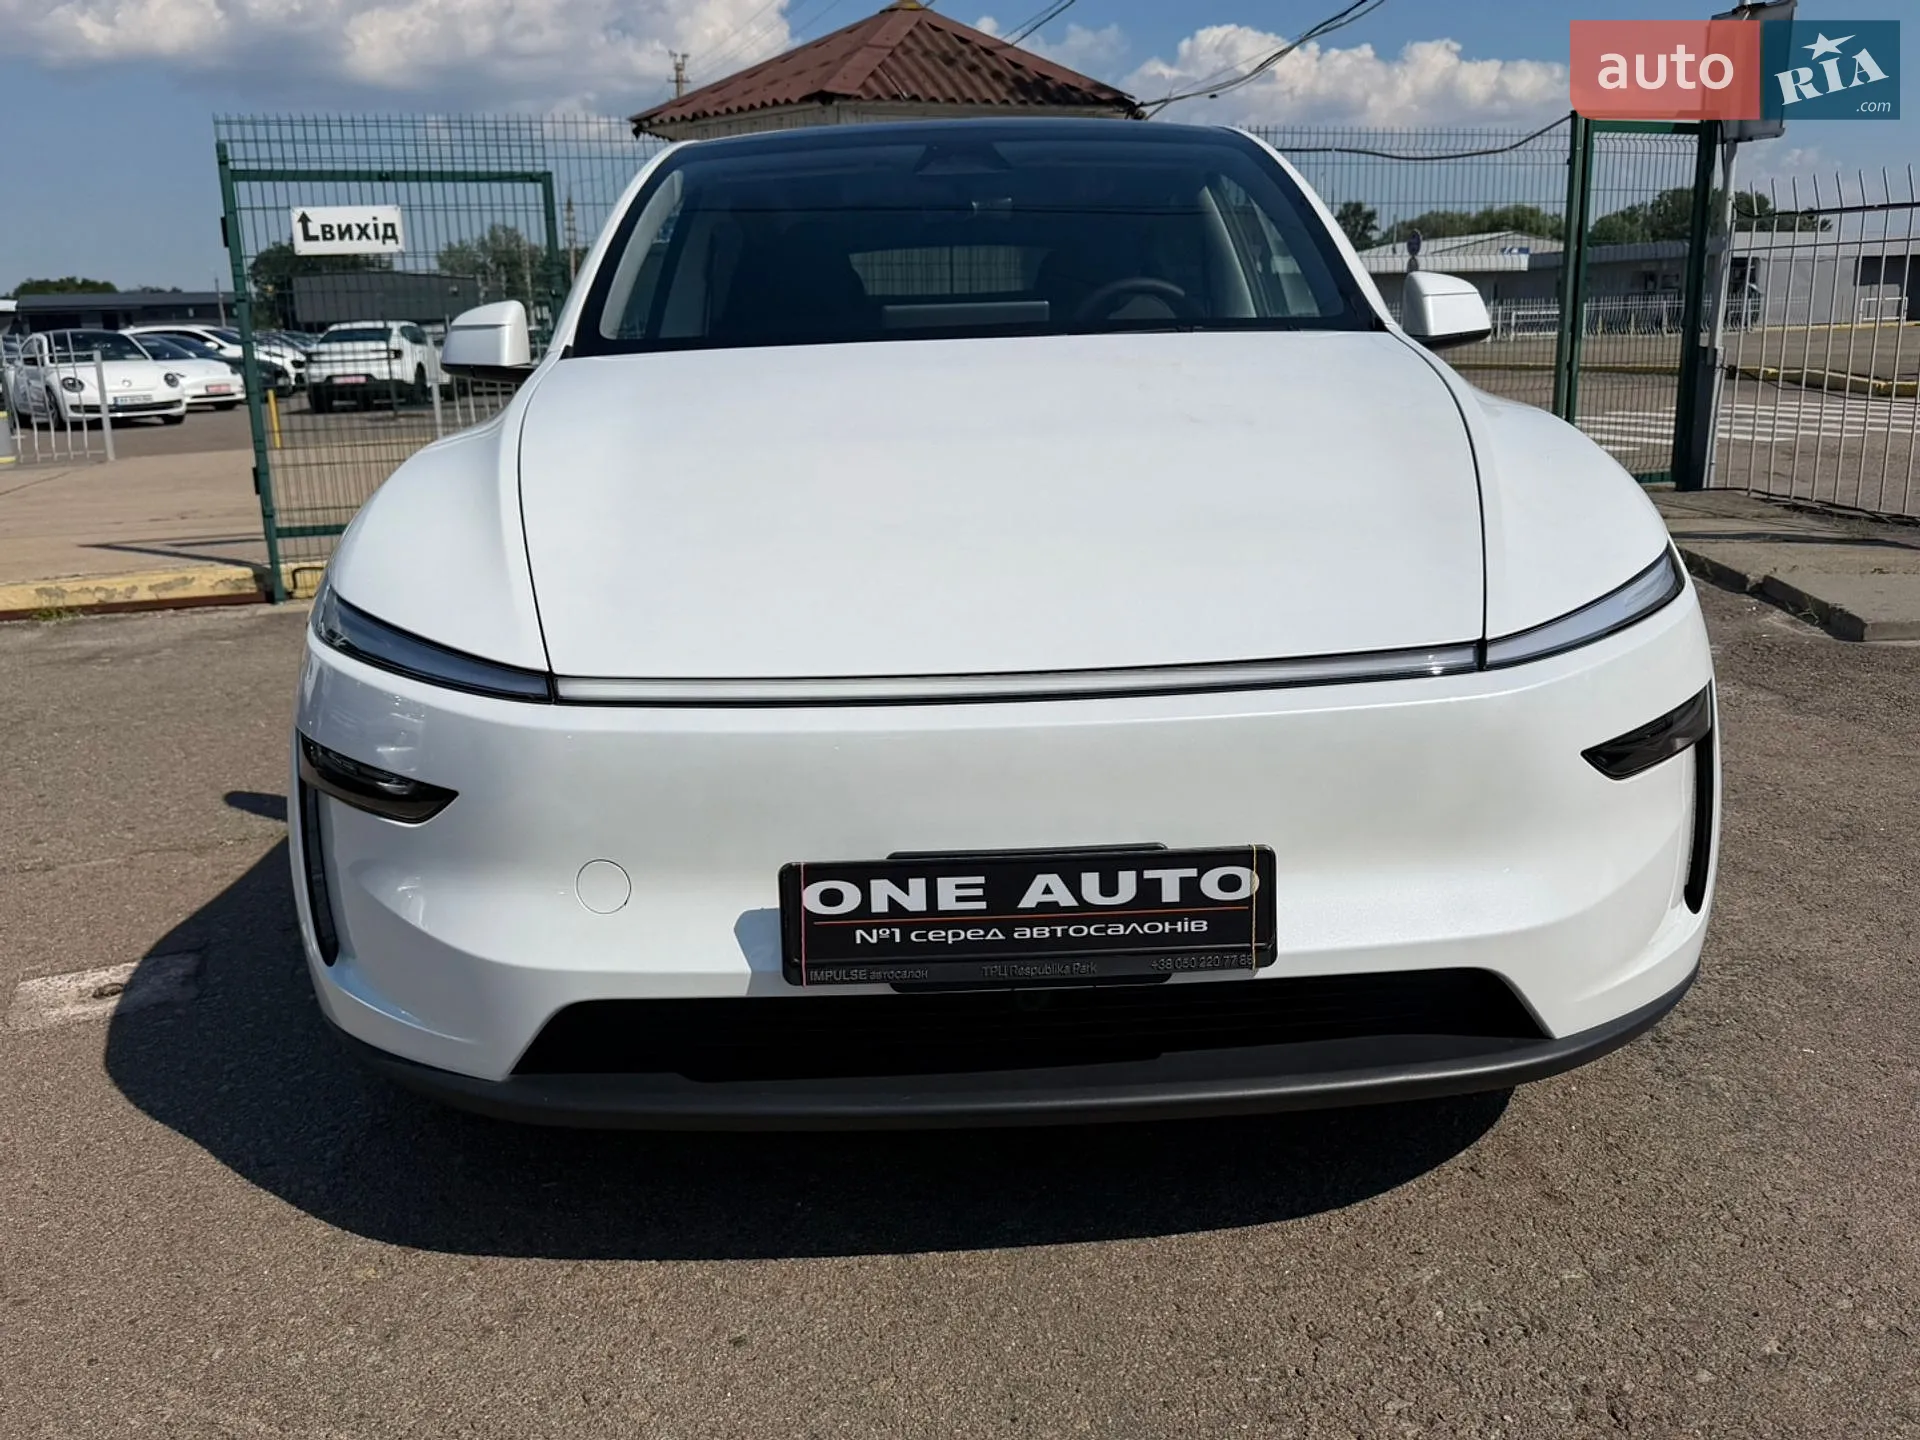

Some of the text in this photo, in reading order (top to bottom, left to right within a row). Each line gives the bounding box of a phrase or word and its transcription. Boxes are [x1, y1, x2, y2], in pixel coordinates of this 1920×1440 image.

[320, 216, 399, 245] вихід
[803, 866, 1259, 915] ONE AUTO
[855, 917, 1208, 945] №1 серед автосалонів
[810, 968, 867, 981] IMPULSE
